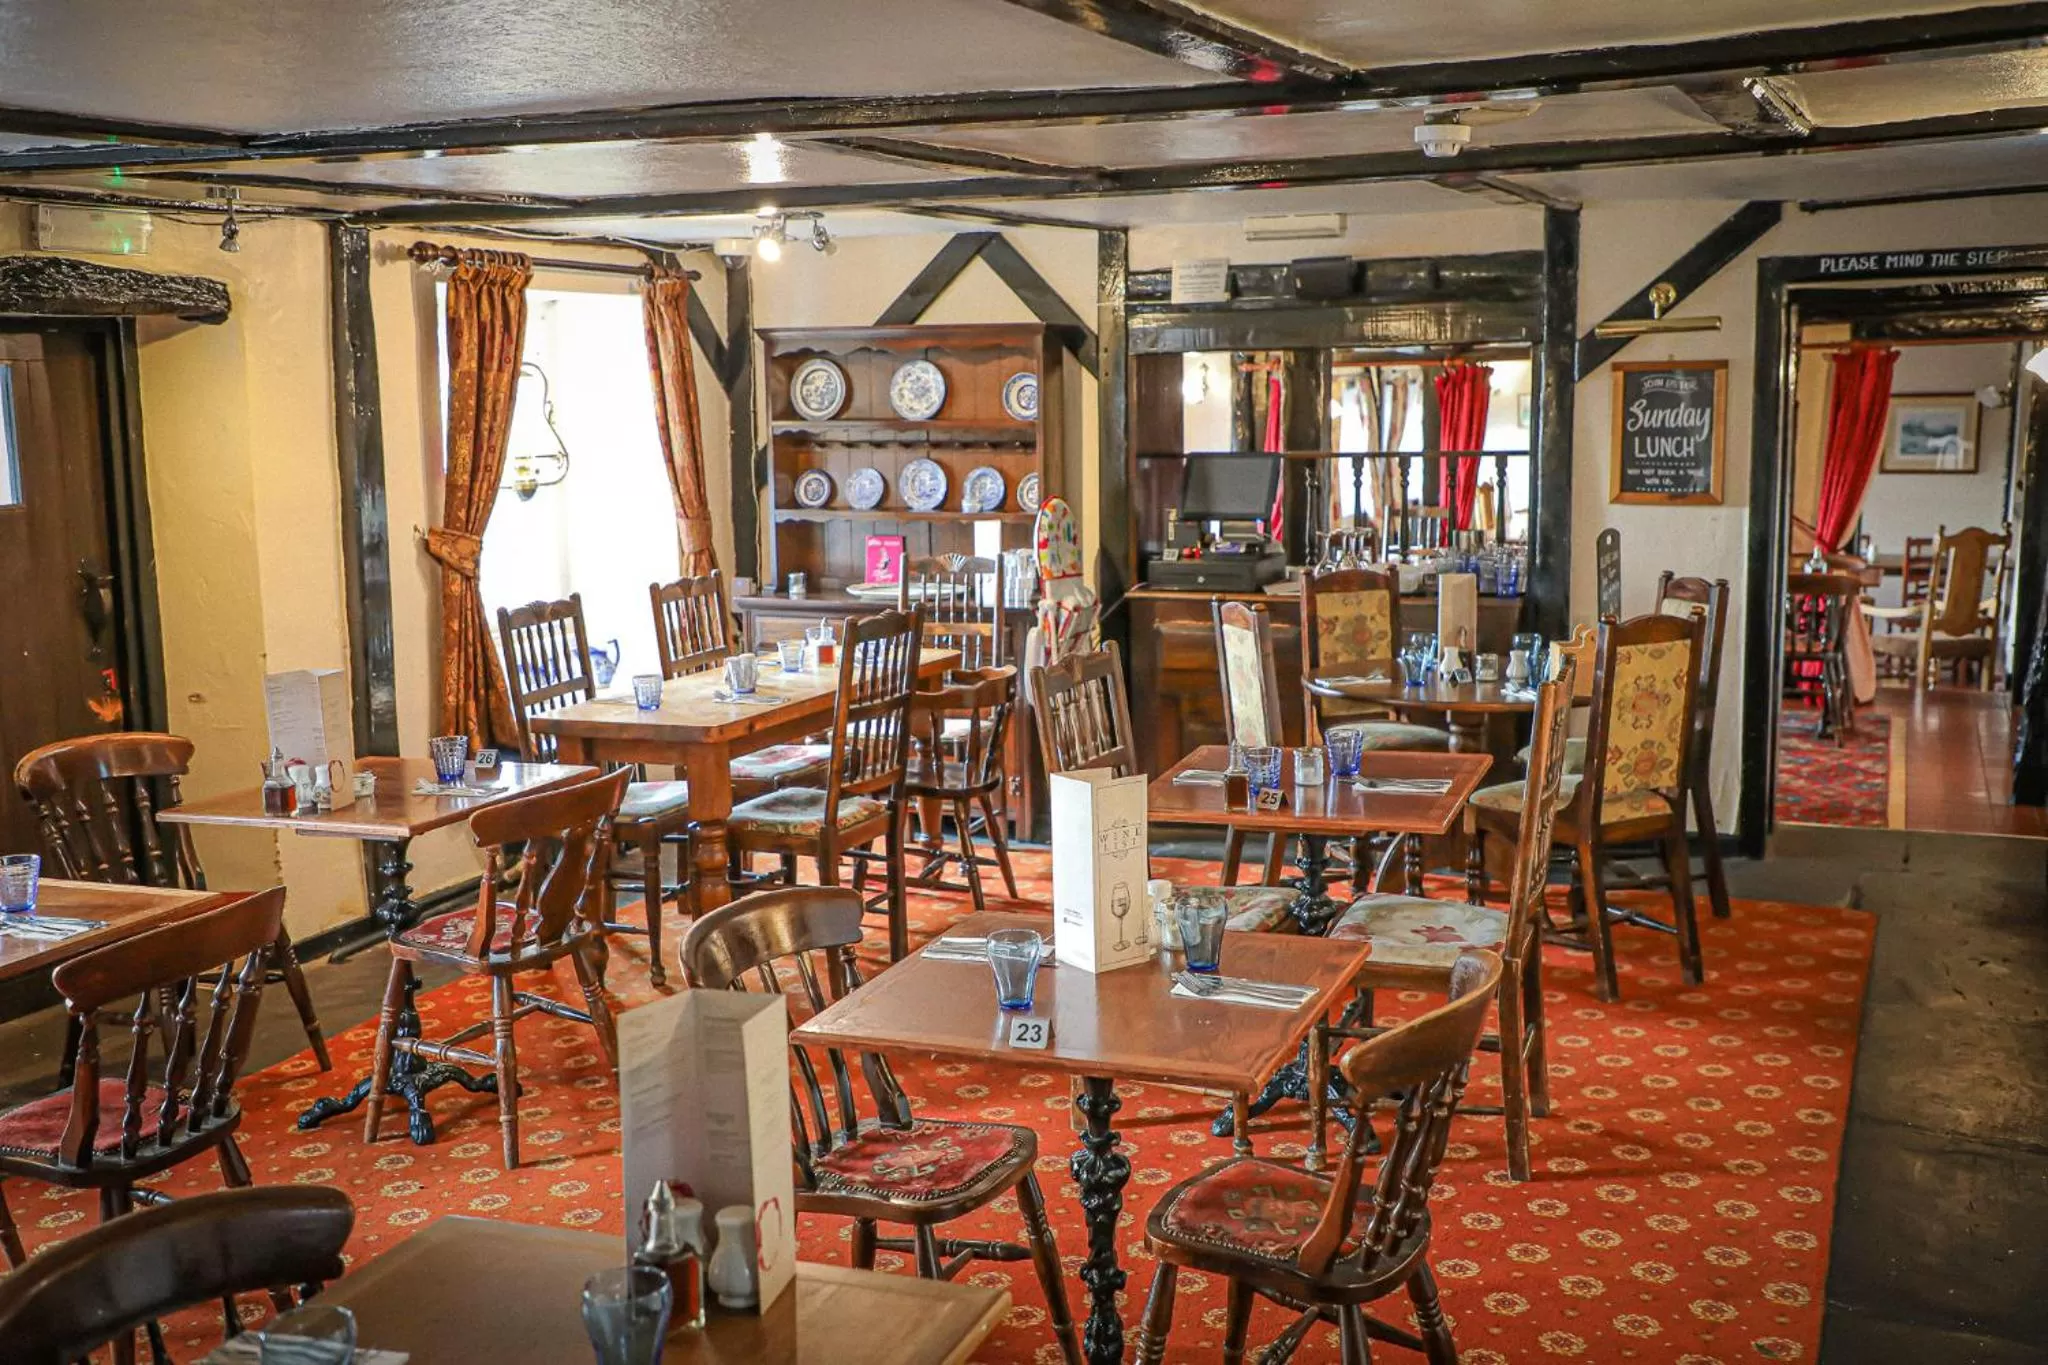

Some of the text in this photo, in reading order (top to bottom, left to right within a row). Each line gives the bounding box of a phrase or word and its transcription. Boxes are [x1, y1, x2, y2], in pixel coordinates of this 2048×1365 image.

[1820, 250, 2009, 273] PLEASE MIND THE STEP
[1626, 399, 1712, 442] Sunday
[1635, 436, 1695, 458] LUNCH
[478, 752, 494, 764] 26
[1261, 791, 1278, 804] 25
[1015, 1023, 1043, 1043] 23
